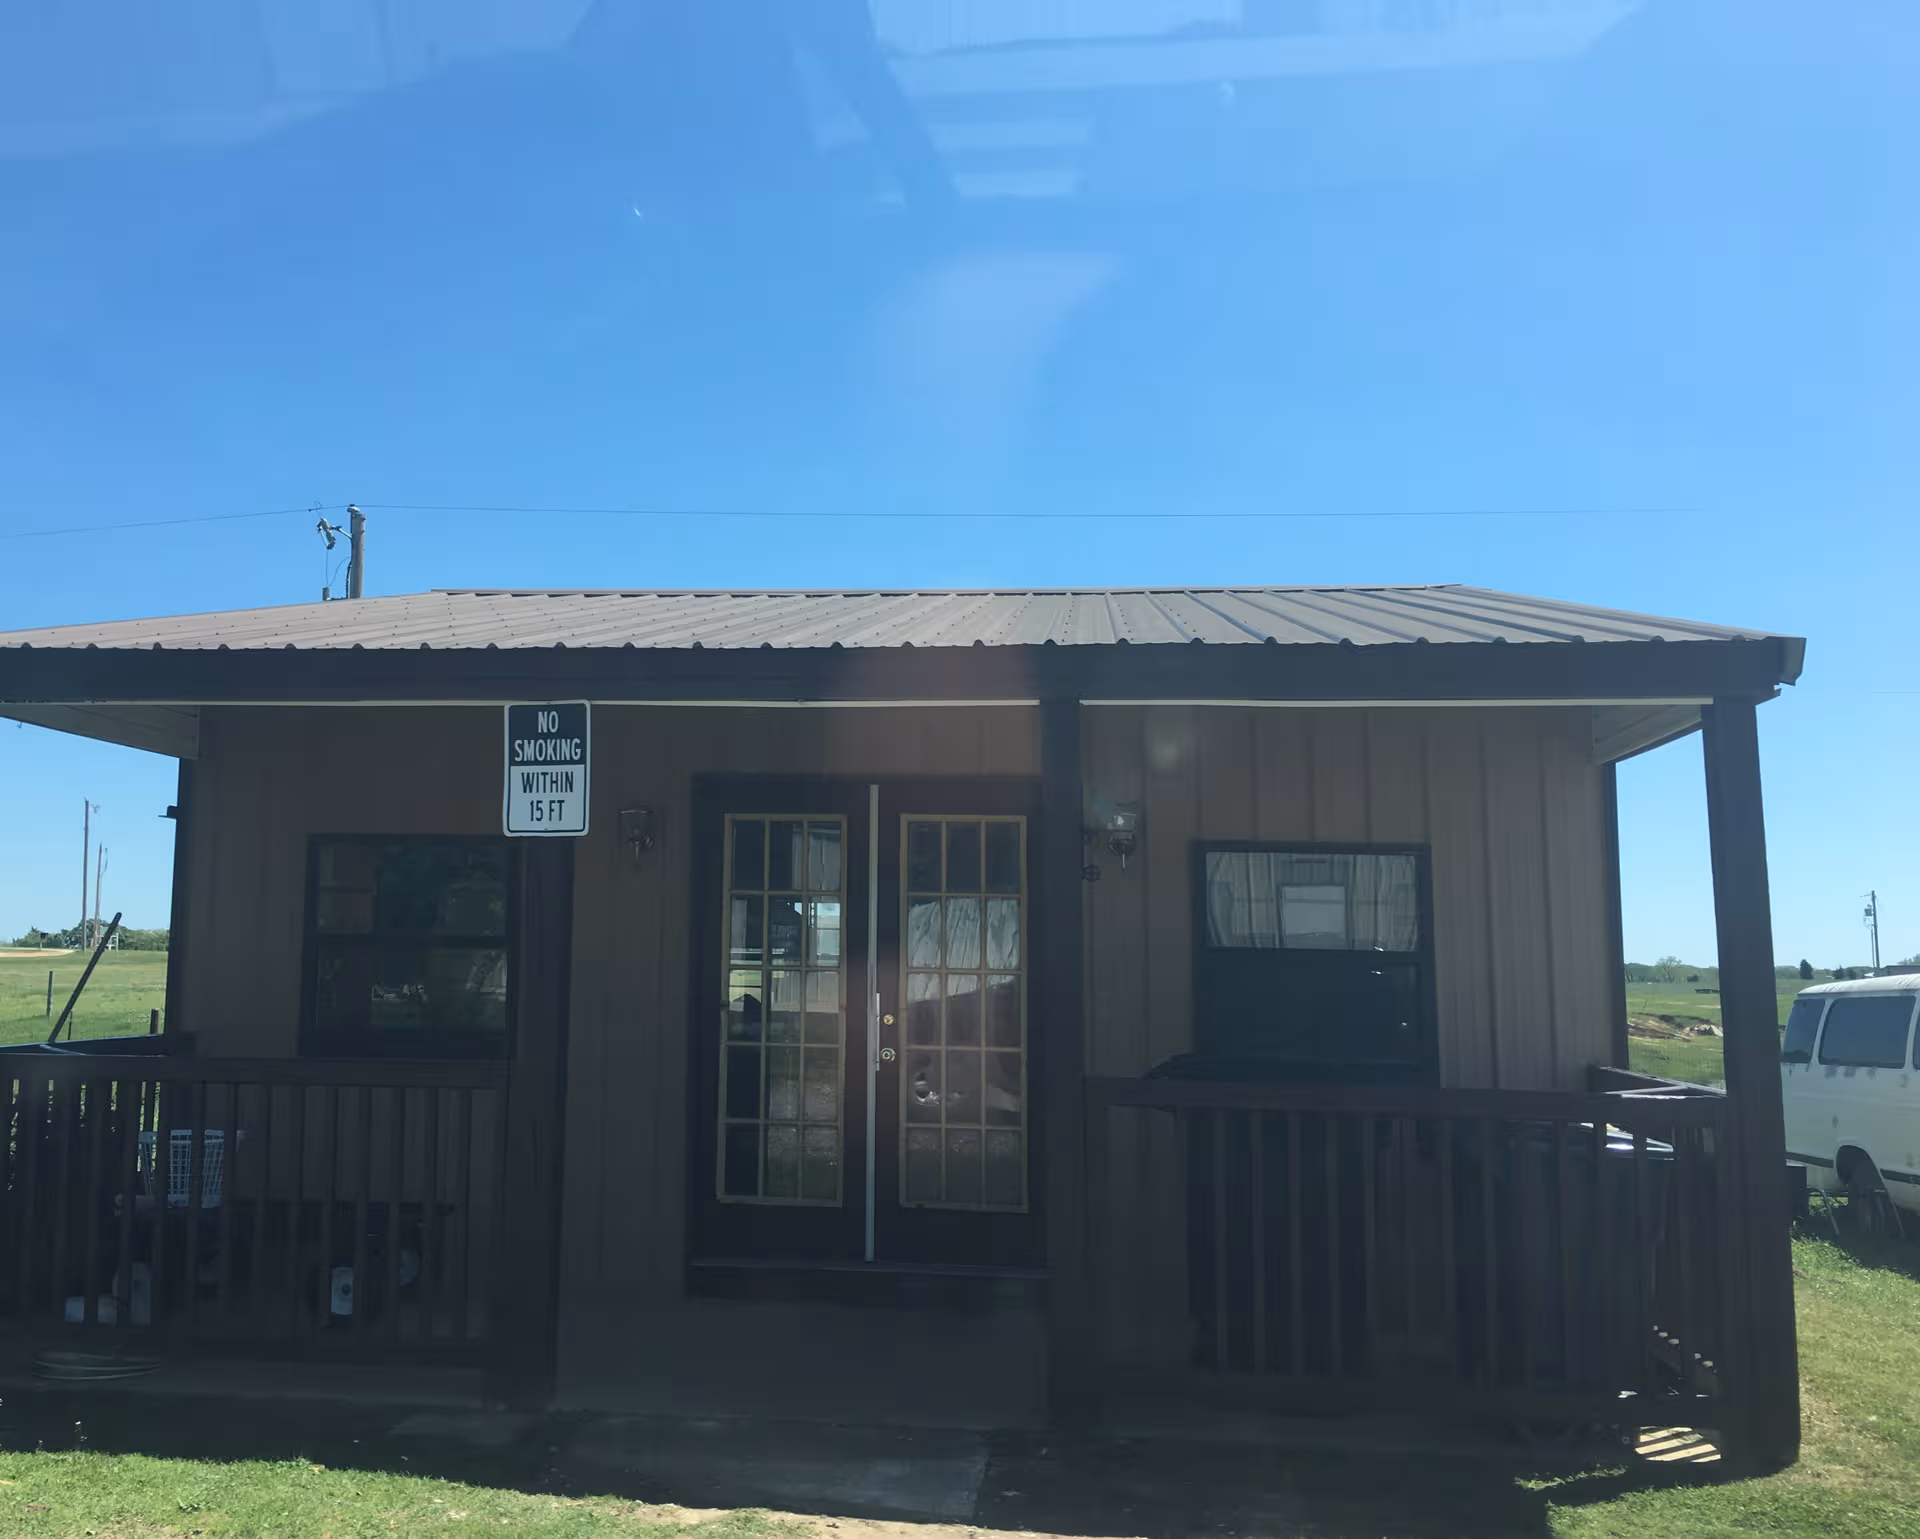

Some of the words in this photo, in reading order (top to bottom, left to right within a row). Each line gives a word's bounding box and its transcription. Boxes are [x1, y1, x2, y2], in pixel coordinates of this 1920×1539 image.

[538, 711, 559, 733] NO
[514, 738, 581, 761] SMOKING
[521, 771, 574, 793] WITHIN
[530, 800, 543, 822] 15
[549, 800, 565, 821] FT
